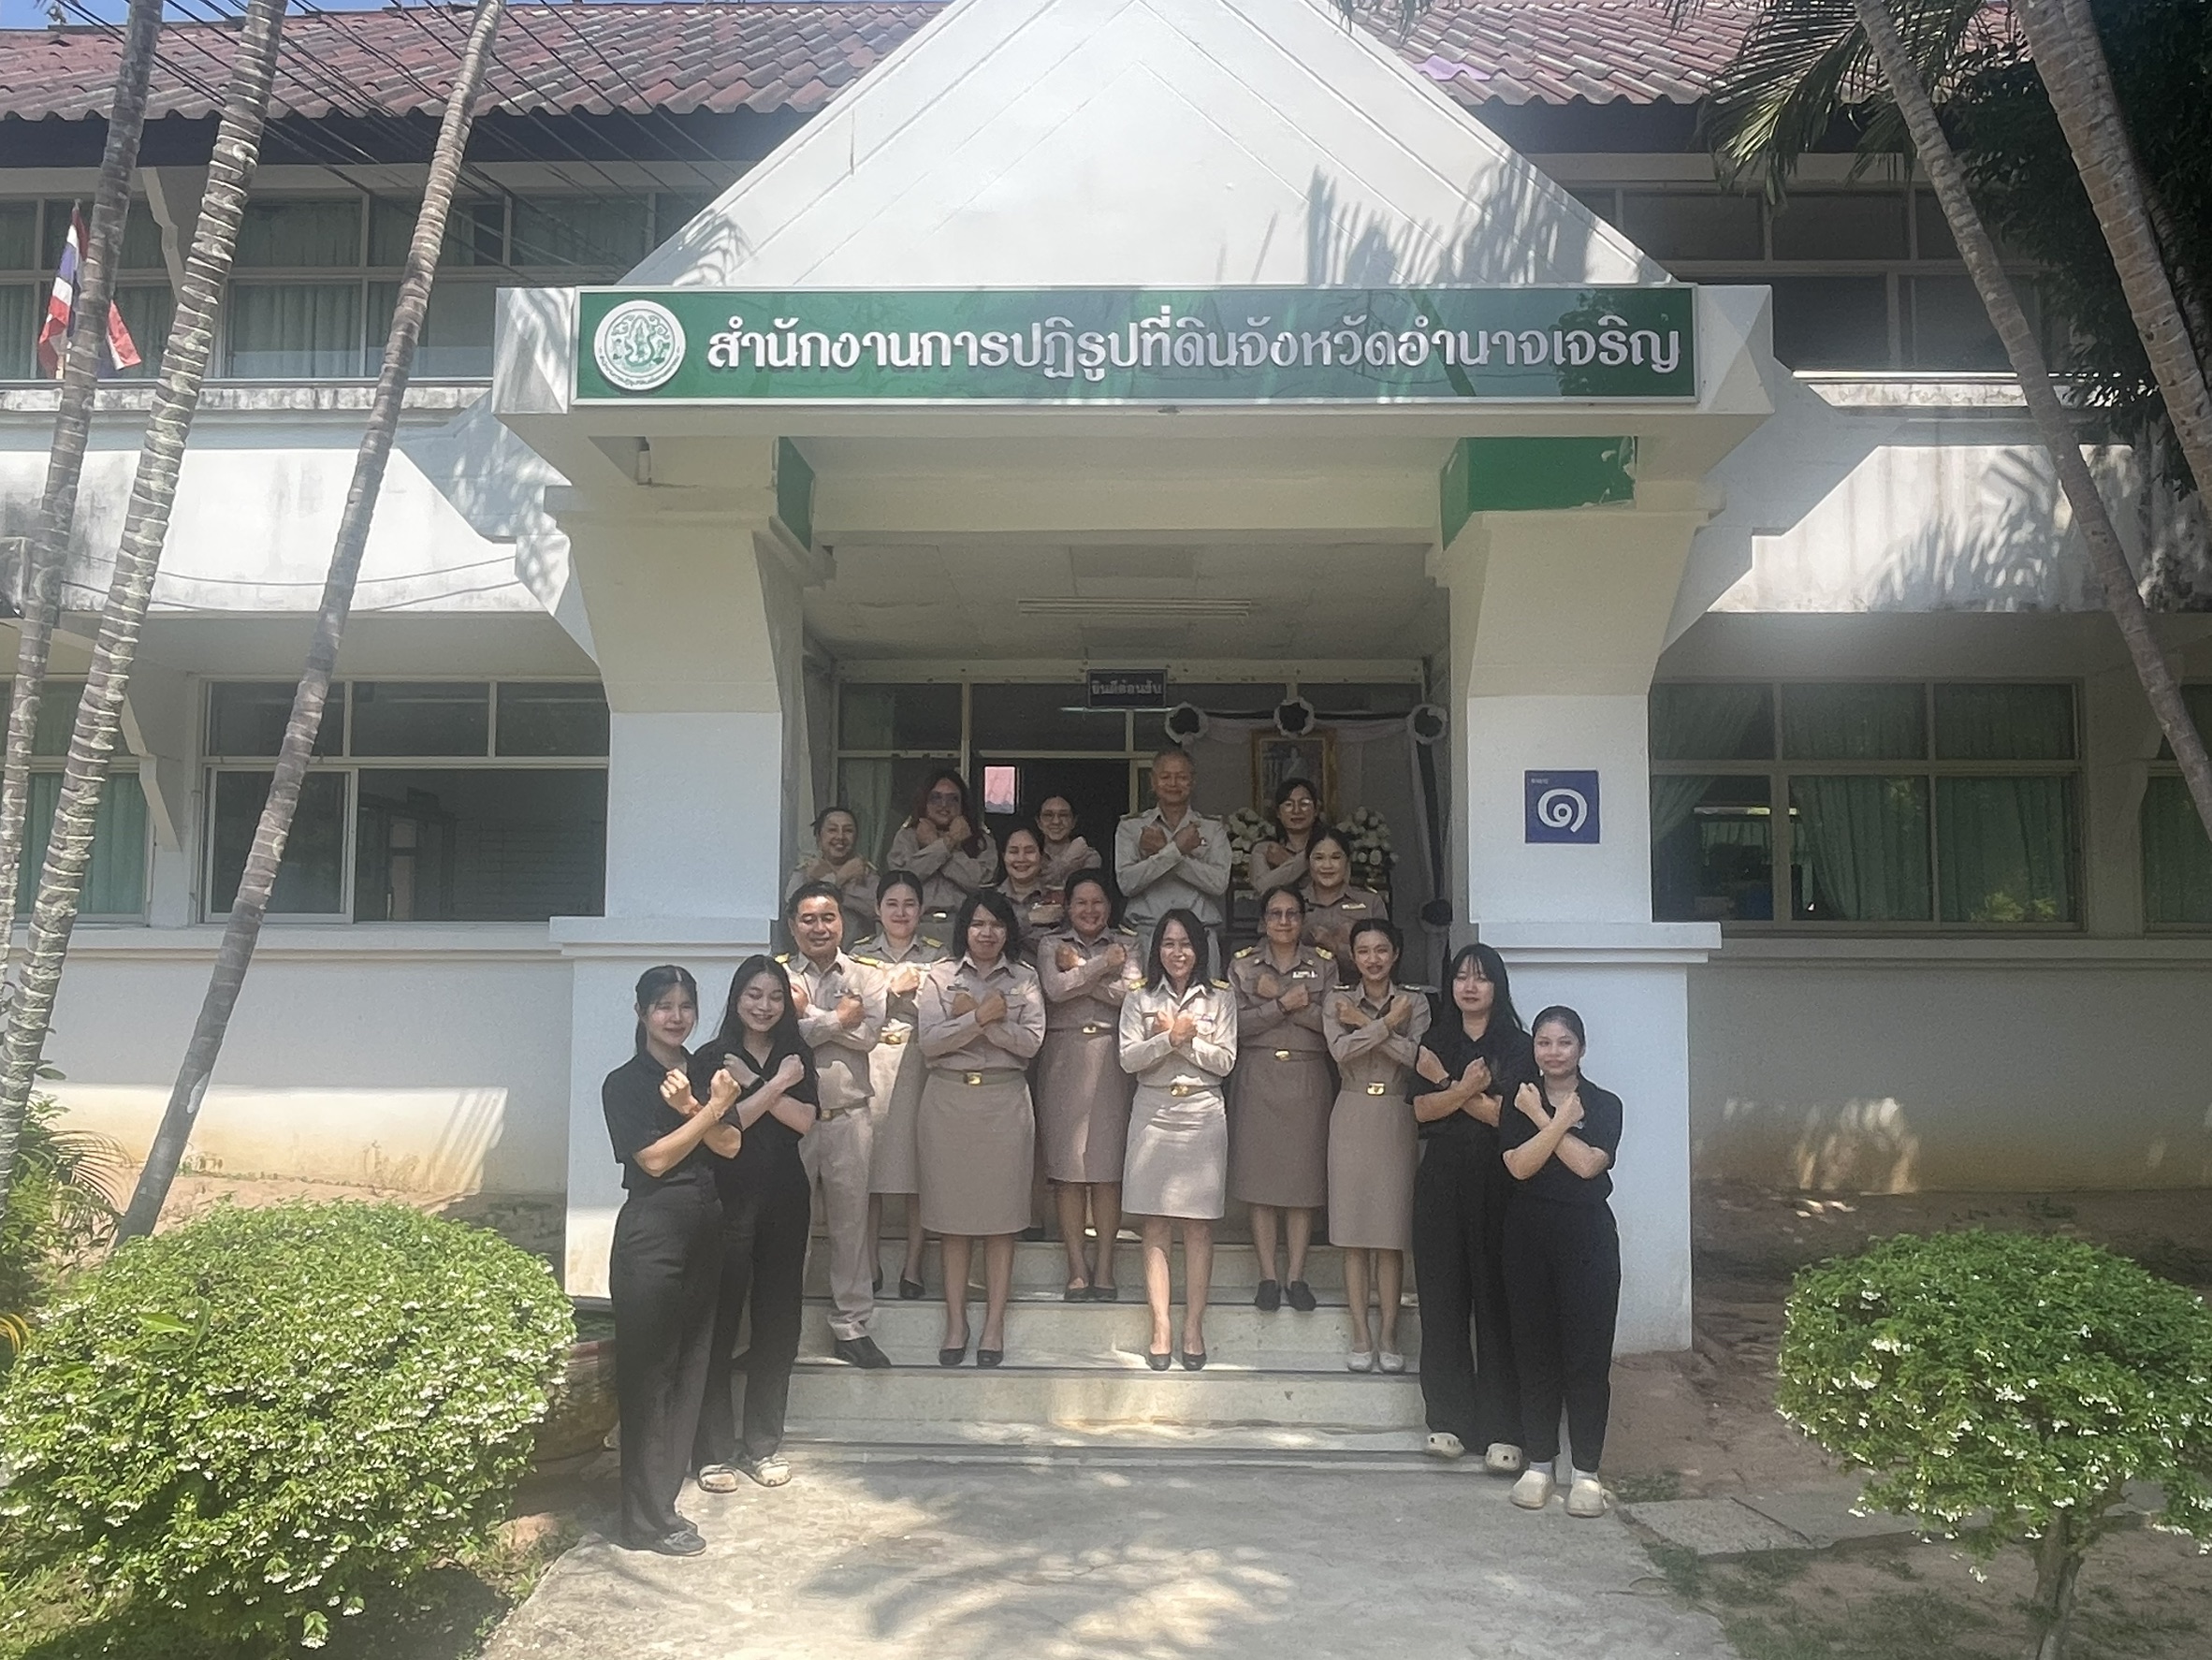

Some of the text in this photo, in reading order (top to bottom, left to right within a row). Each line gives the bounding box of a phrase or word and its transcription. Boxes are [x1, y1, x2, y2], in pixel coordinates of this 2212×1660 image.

[707, 305, 1681, 382] สำนักงานการปฏิรูปที่ดินจังหวัดอำนาจเจริญ
